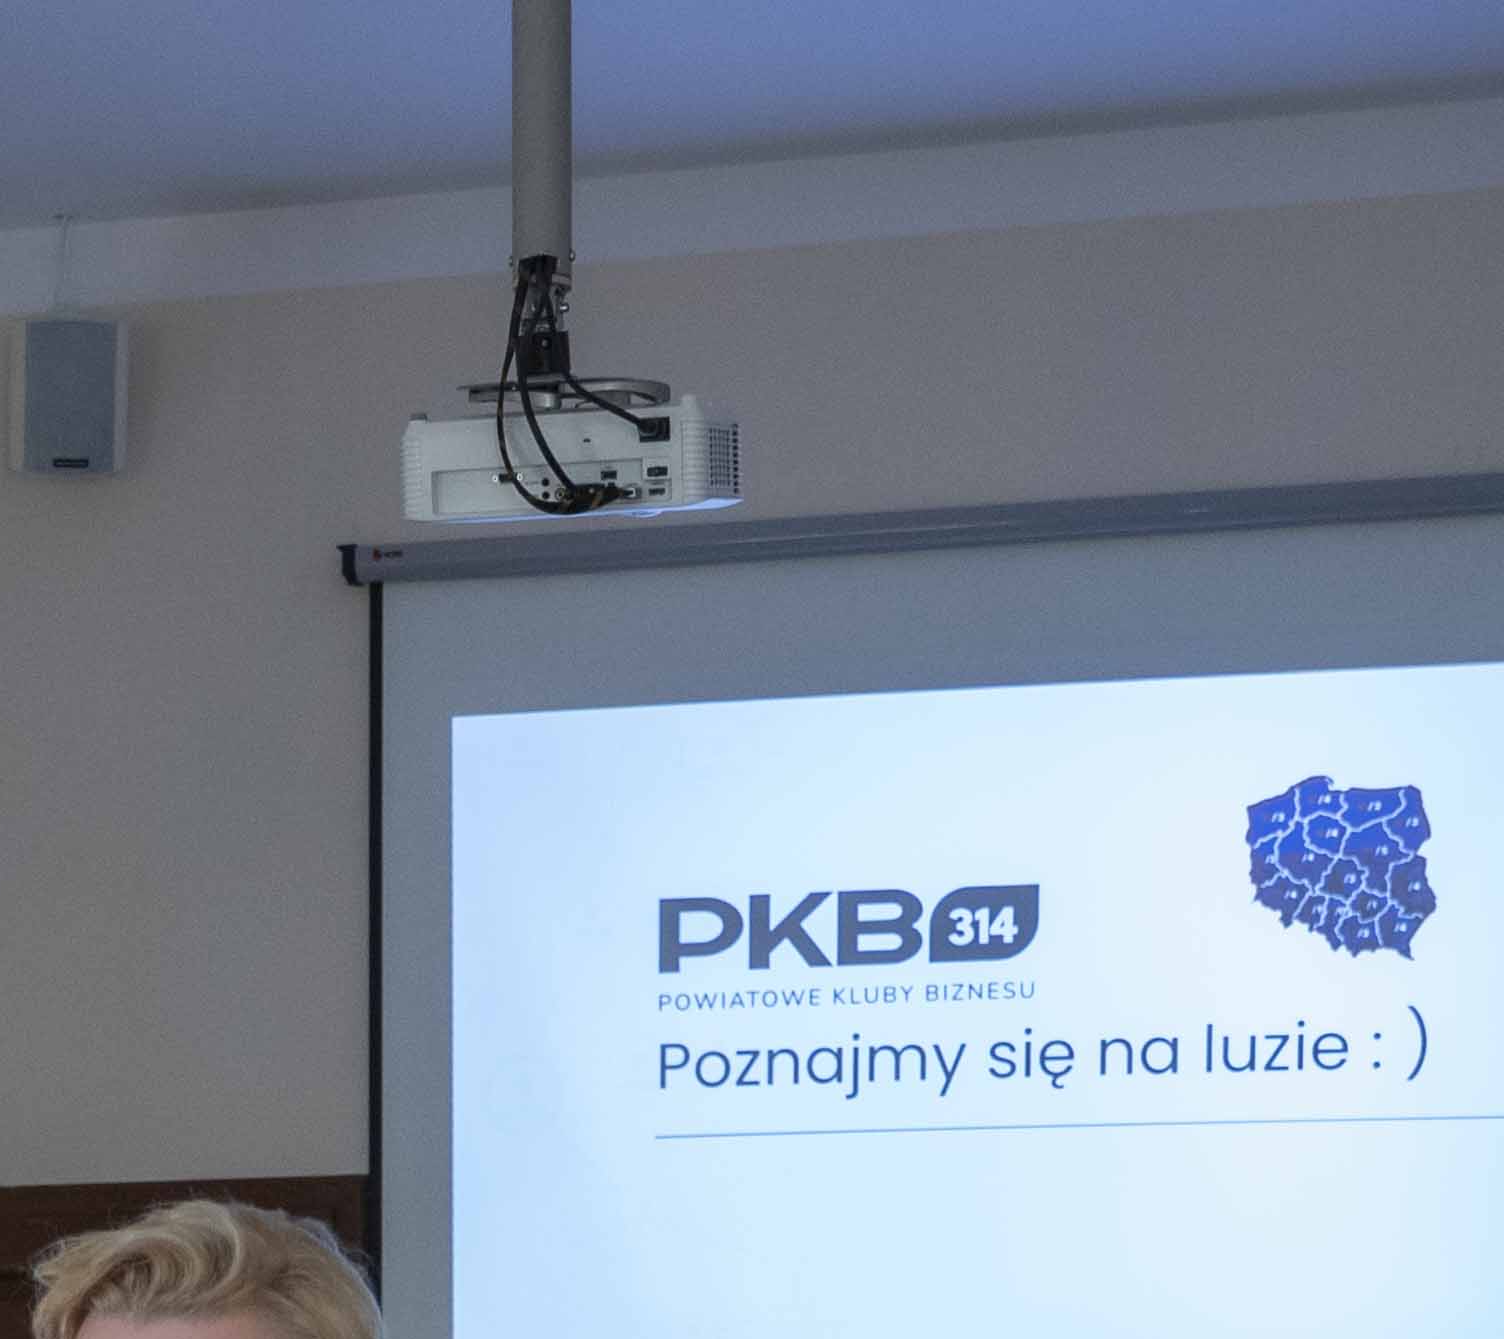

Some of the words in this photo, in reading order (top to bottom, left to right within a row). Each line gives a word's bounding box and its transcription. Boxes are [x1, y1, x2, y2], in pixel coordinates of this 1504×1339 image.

[659, 888, 923, 973] PKB
[948, 906, 1019, 946] 314
[659, 988, 821, 1011] POWIATOWE
[833, 985, 913, 1006] KLUBY
[926, 981, 1036, 1002] BIZNESU
[660, 1032, 967, 1099] Poznajmy
[988, 1027, 1075, 1089] się
[1099, 1036, 1179, 1076] na
[1206, 1020, 1349, 1073] luzie
